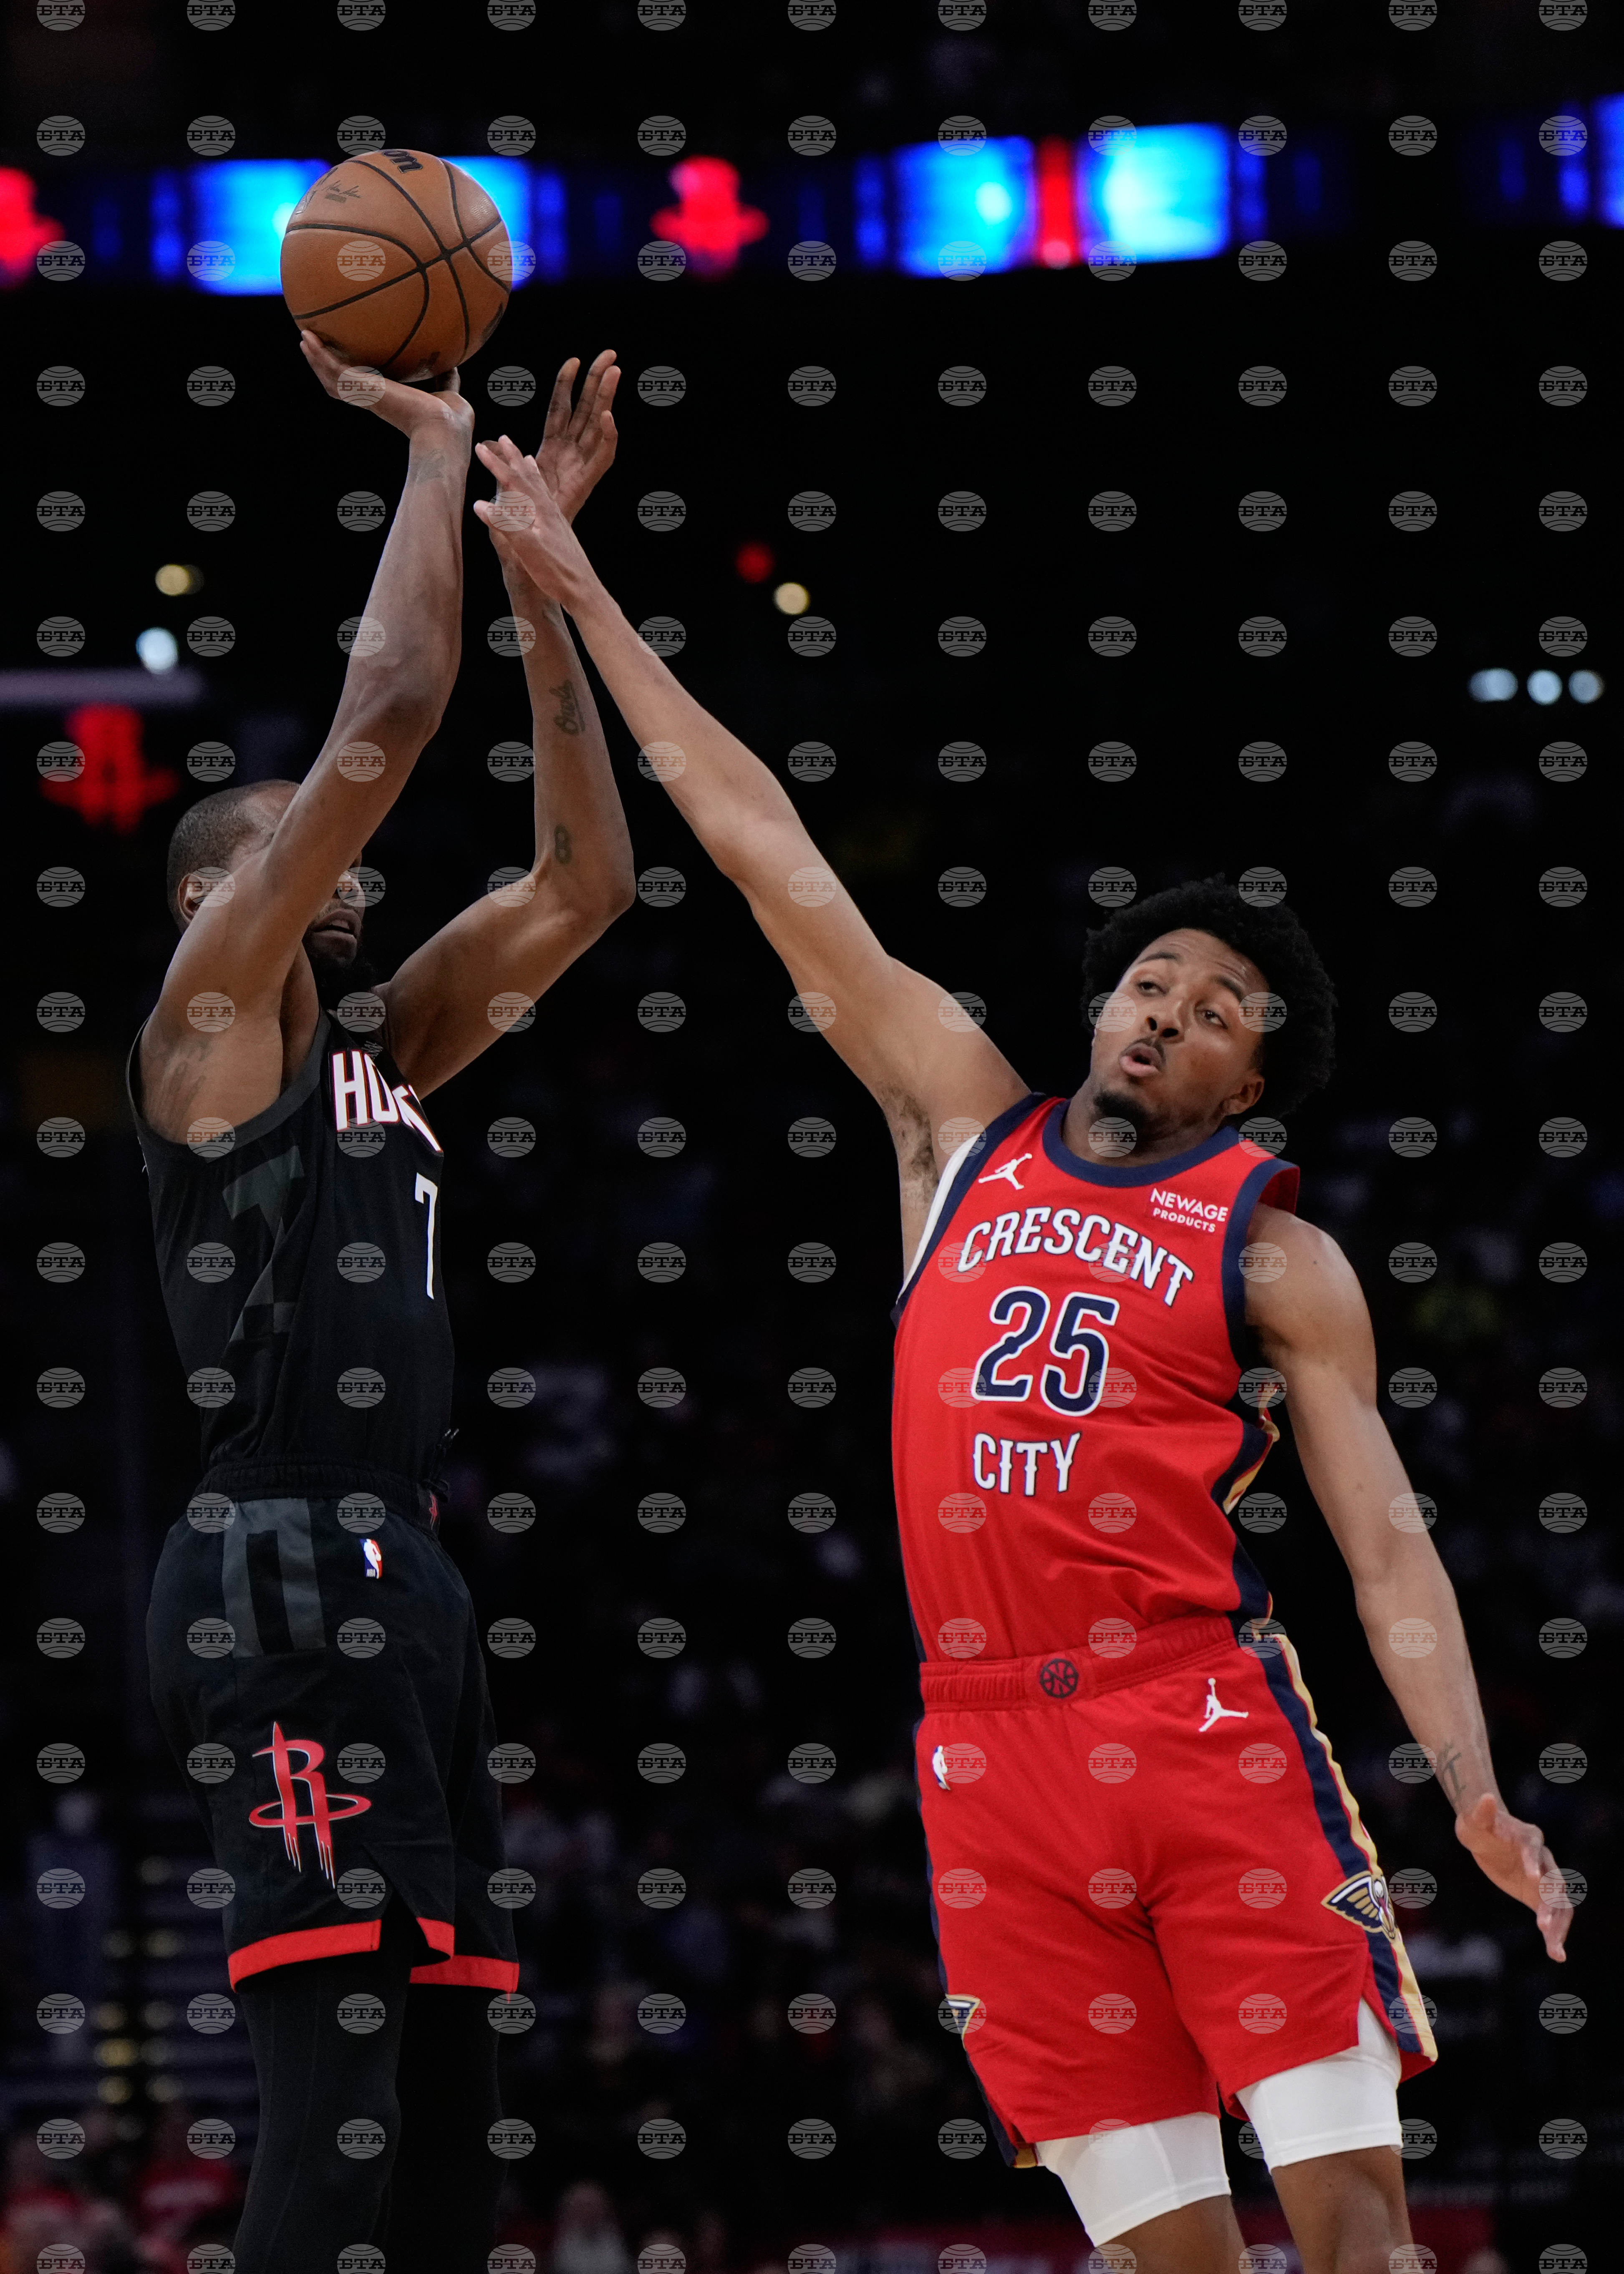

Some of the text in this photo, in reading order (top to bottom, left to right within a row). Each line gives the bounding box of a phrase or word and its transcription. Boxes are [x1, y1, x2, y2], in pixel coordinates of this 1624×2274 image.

[414, 1172, 439, 1300] 7
[1150, 1188, 1229, 1222] NEWAGE
[1152, 1207, 1216, 1233] PRODUCTS
[957, 1206, 1194, 1307] CRESCENT
[971, 1285, 1120, 1417] 25
[972, 1431, 1082, 1497] CITY
